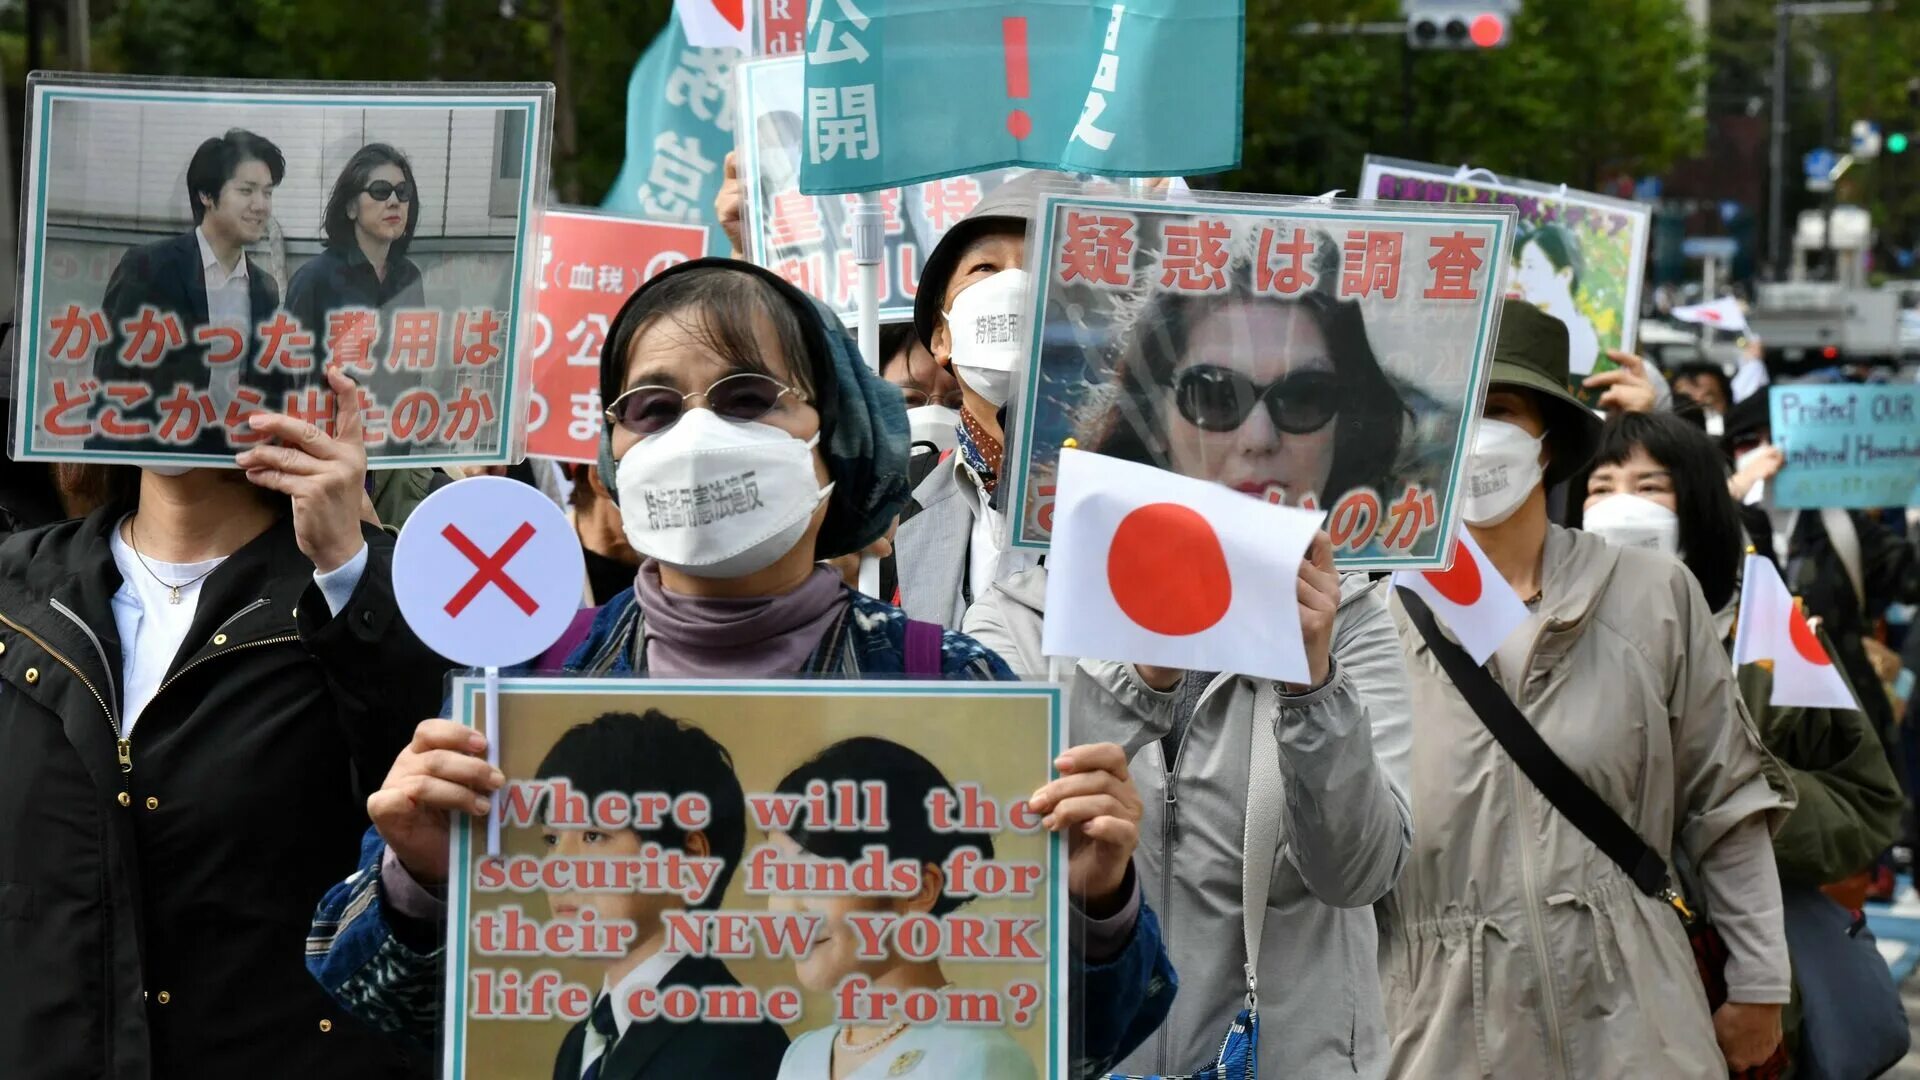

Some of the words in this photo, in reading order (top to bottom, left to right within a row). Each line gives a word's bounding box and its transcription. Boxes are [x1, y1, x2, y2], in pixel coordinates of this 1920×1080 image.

[807, 0, 881, 165] 公開
[1060, 211, 1486, 302] 疑惑は調査
[49, 304, 500, 372] かかった費用は
[499, 780, 709, 829] Where
[750, 781, 887, 828] will
[930, 785, 1039, 831] the
[478, 844, 723, 901] security
[748, 847, 920, 894] funds
[947, 850, 1041, 895] for
[476, 906, 634, 955] their
[665, 913, 818, 957] NEW
[854, 915, 1042, 961] YORK
[474, 972, 590, 1019] life
[626, 988, 800, 1022] come
[838, 976, 1040, 1024] from?
